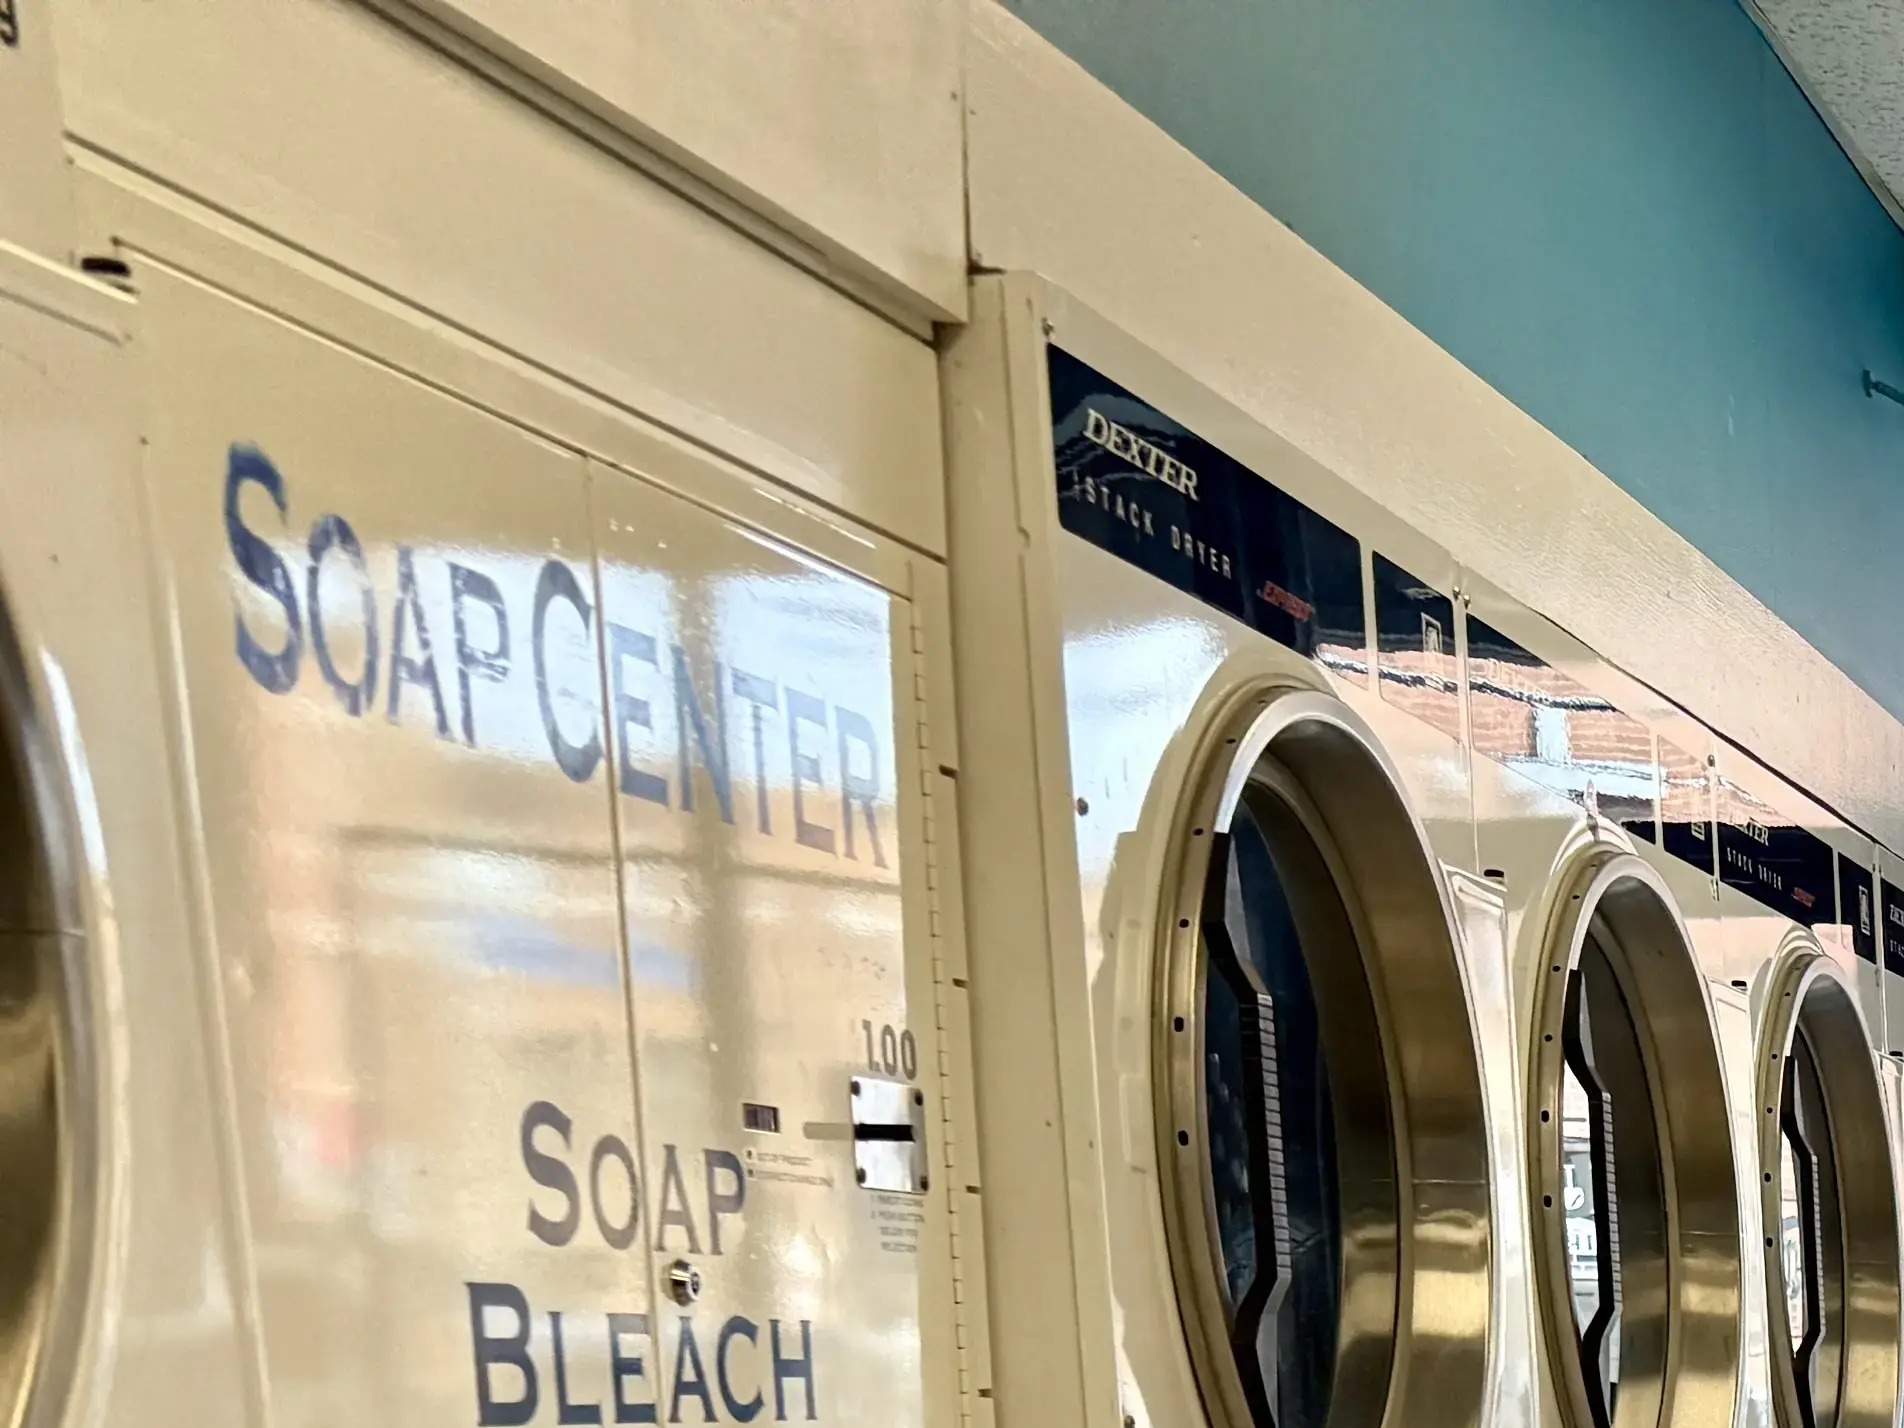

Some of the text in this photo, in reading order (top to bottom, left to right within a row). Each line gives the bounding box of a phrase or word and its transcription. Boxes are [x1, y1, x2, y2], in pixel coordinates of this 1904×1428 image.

[1083, 408, 1199, 501] DEXTER
[1084, 476, 1232, 580] STACK DRYER
[223, 439, 891, 869] SOAP CENTER
[521, 1099, 747, 1259] SOAP
